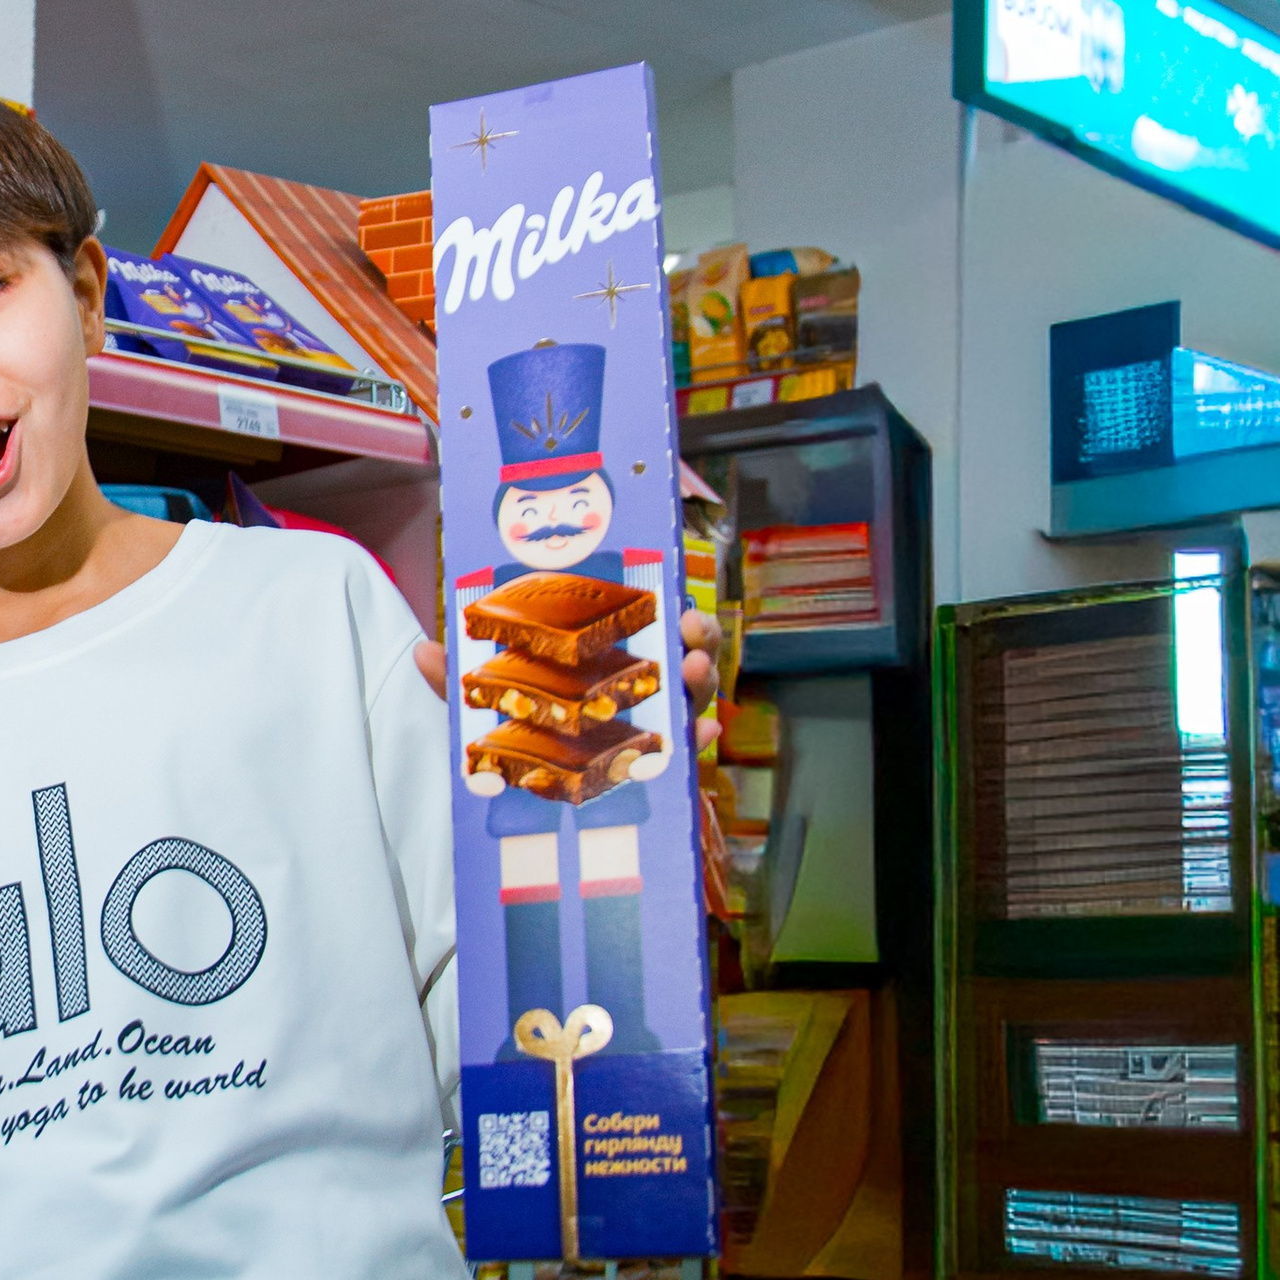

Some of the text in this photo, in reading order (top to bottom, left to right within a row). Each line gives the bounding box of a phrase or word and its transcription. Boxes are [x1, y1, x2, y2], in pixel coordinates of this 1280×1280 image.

[435, 171, 662, 315] Milka
[1, 1098, 70, 1146] yoga
[78, 1079, 108, 1111] to
[583, 1109, 660, 1137] Собери
[584, 1134, 683, 1159] гирлянду
[584, 1156, 688, 1179] нежности
